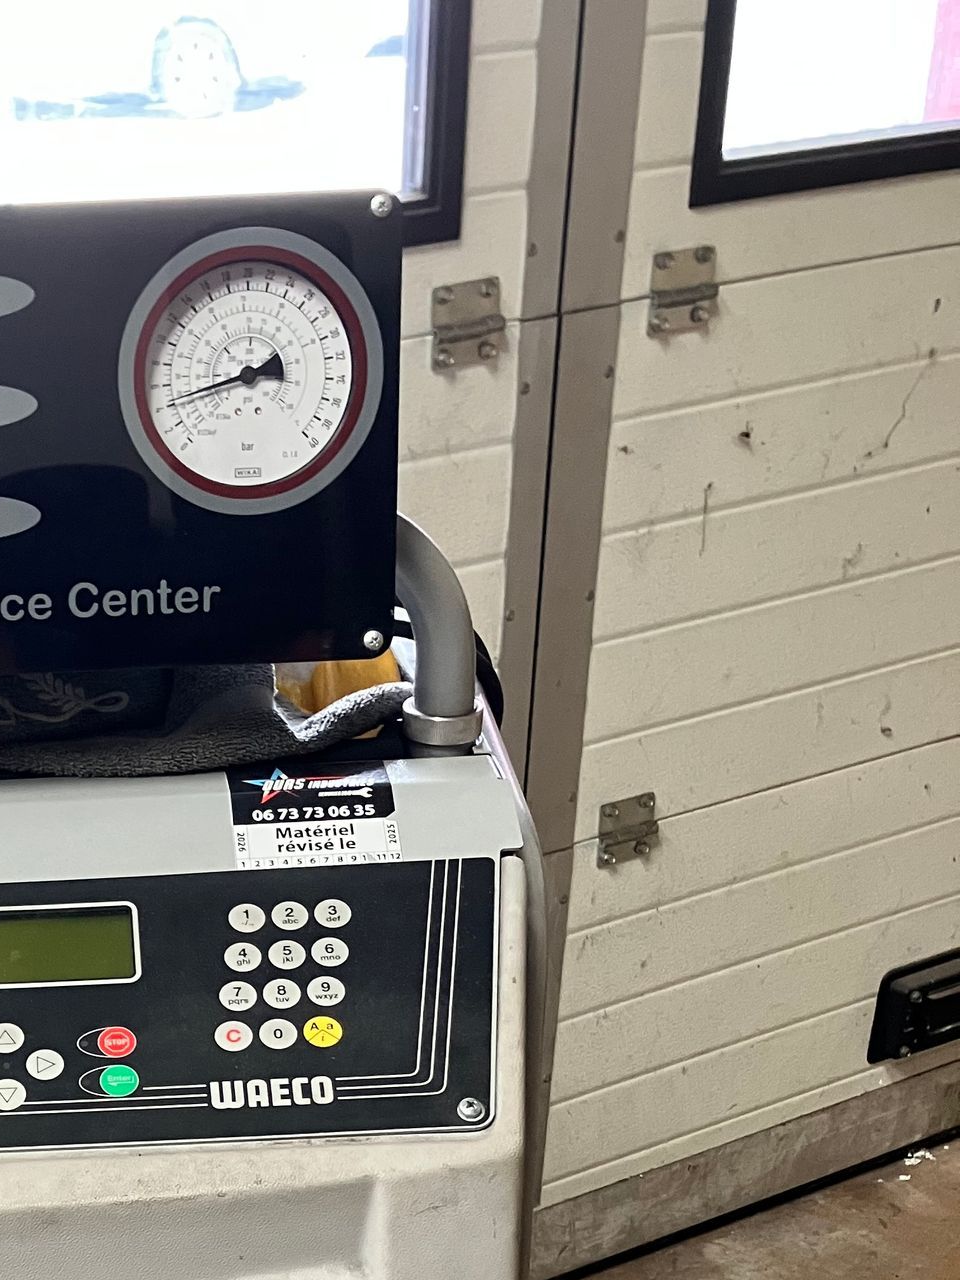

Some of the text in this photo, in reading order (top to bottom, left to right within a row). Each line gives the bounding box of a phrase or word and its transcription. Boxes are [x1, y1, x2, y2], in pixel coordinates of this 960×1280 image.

[265, 268, 276, 280] 22
[329, 326, 340, 339] 30
[335, 350, 346, 361] 32
[336, 374, 346, 385] 34
[331, 397, 342, 408] 36
[321, 418, 333, 430] 38
[241, 442, 255, 451] bar
[308, 437, 319, 449] 40
[67, 578, 222, 618] Center
[252, 803, 376, 822] 06 73 73 06 35
[275, 823, 355, 839] Matériel
[386, 824, 397, 844] 2025
[237, 832, 247, 852] 2026
[277, 837, 356, 853] révisé le
[376, 853, 387, 861] 11
[243, 909, 249, 919] 1
[285, 907, 295, 917] 2
[328, 905, 337, 915] 3
[238, 948, 248, 958] 4
[283, 945, 292, 955] 5
[325, 943, 334, 954] 6
[282, 956, 294, 964] jkl
[233, 986, 242, 997] 7
[277, 985, 286, 995] 8
[321, 982, 331, 992] 9
[310, 1022, 320, 1031] A
[226, 1029, 241, 1043] C
[273, 1028, 283, 1039] 0
[104, 1038, 129, 1046] STOP
[209, 1075, 335, 1109] WAECO
